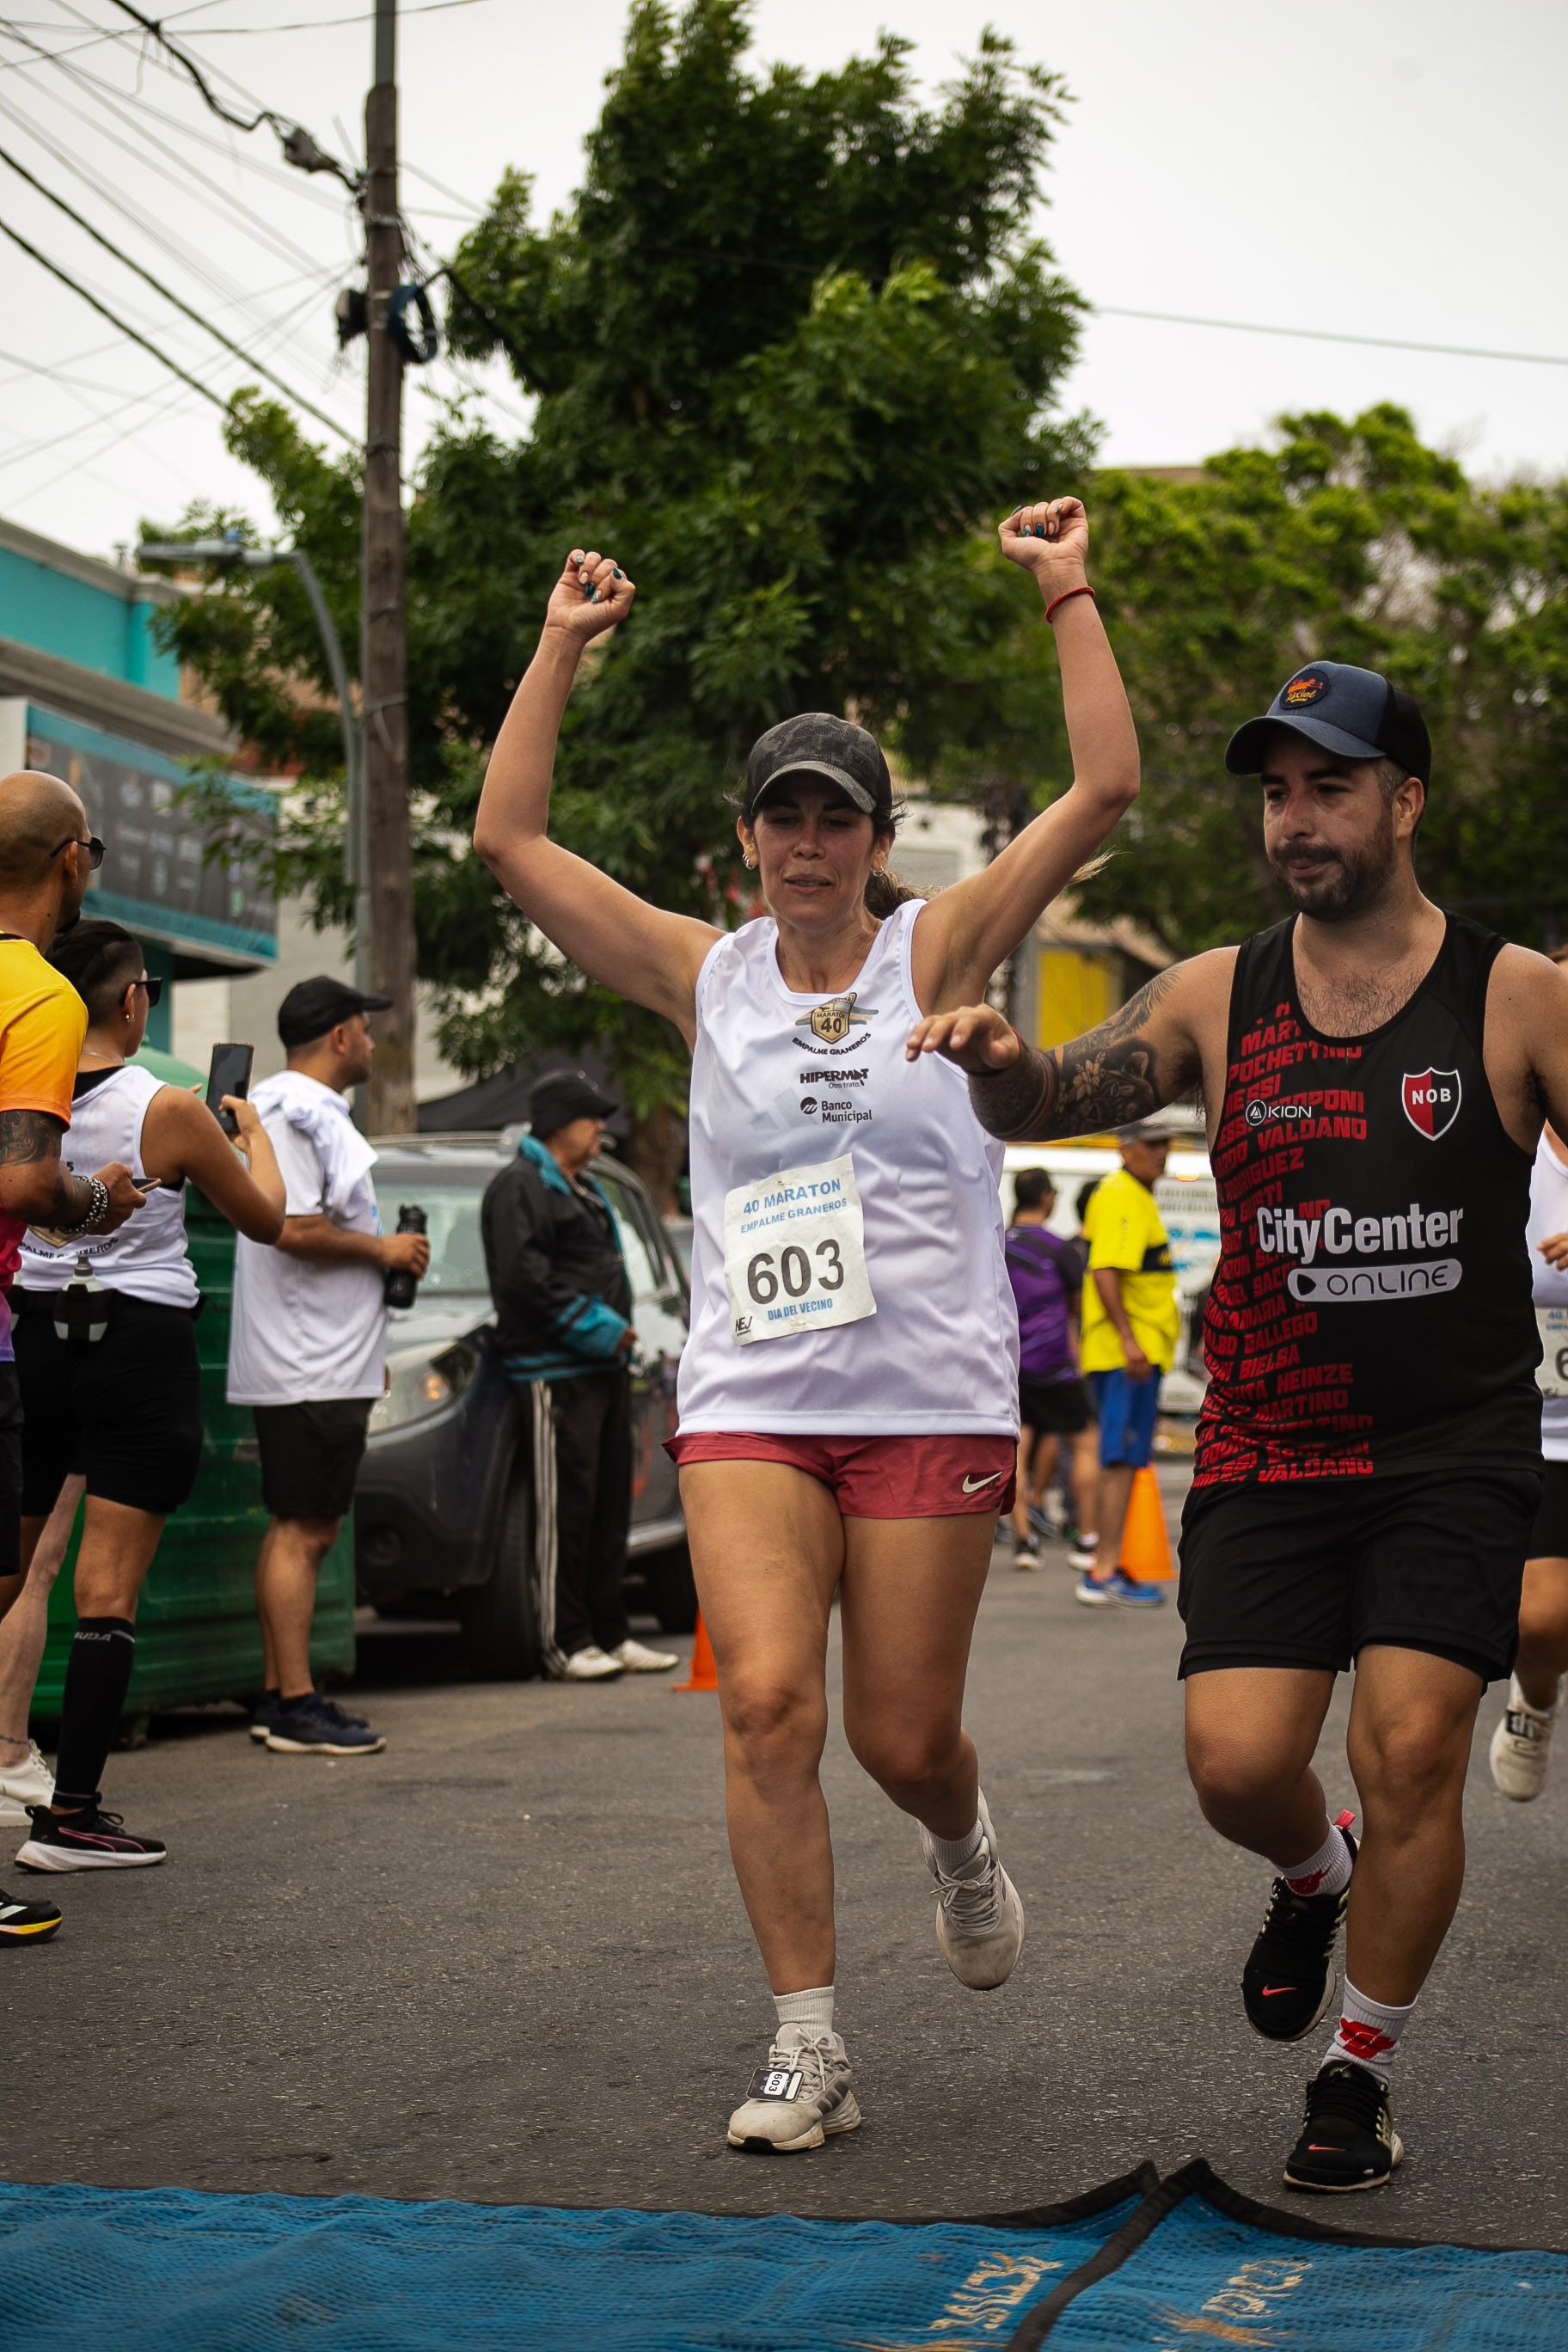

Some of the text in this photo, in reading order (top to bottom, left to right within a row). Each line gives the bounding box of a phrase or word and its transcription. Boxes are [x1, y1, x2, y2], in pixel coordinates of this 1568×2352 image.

[820, 1017, 842, 1033] 40
[792, 1032, 872, 1056] EMPALME GRANEROS
[821, 1100, 853, 1112] Banco
[1412, 1087, 1452, 1106] NOB
[822, 1109, 873, 1124] Municipal
[1257, 1116, 1368, 1154] VALDANO
[743, 1178, 842, 1216] 40 MARATON
[740, 1197, 848, 1234] EMPALME GRANEROS
[746, 1238, 845, 1305] 603
[767, 1297, 834, 1321] DIA DEL VECINO
[1244, 1311, 1318, 1355] GALLEGO
[1239, 1343, 1301, 1381] BIELSA
[1276, 1363, 1355, 1396] HEINZE
[1253, 1389, 1349, 1422] MARTINO
[769, 2073, 783, 2092] 603
